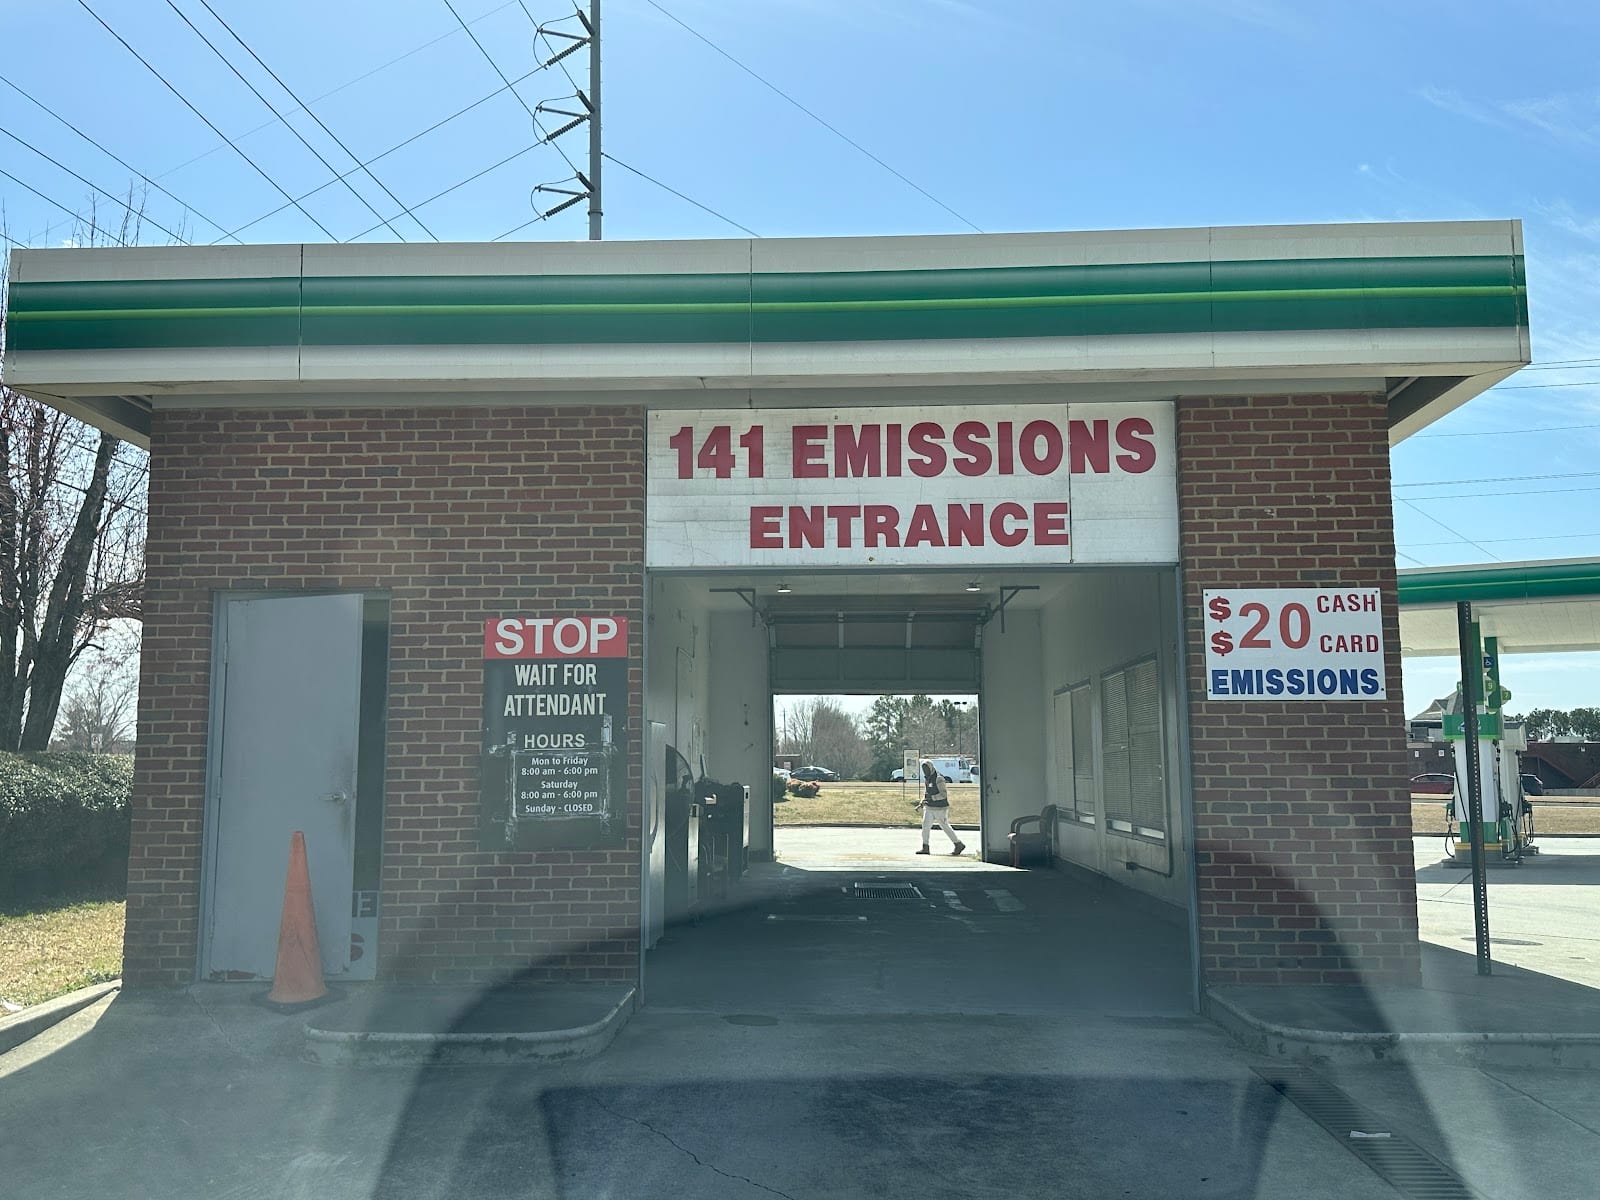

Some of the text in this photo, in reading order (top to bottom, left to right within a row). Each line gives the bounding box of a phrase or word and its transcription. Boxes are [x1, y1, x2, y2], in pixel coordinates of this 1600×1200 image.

[669, 417, 1156, 479] 141 EMISSIONS
[750, 502, 1068, 549] ENTRANCE
[1317, 594, 1376, 613] CASH
[494, 618, 618, 655] STOP
[1320, 635, 1379, 653] CARD
[515, 663, 597, 686] WAIT FOR
[1211, 668, 1380, 695] EMISSIONS
[503, 693, 606, 716] ATTENDANT
[524, 733, 585, 748] HOURS
[531, 756, 588, 766] Mon to Friday
[521, 767, 540, 776] 8:00
[563, 766, 582, 775] 6:00
[584, 767, 598, 776] pm
[541, 779, 578, 789] Saturday
[520, 791, 540, 800] 8:00
[563, 790, 582, 799] 6:00
[584, 791, 598, 800] pm
[525, 804, 556, 814] Sunday
[564, 803, 593, 812] CLOSED
